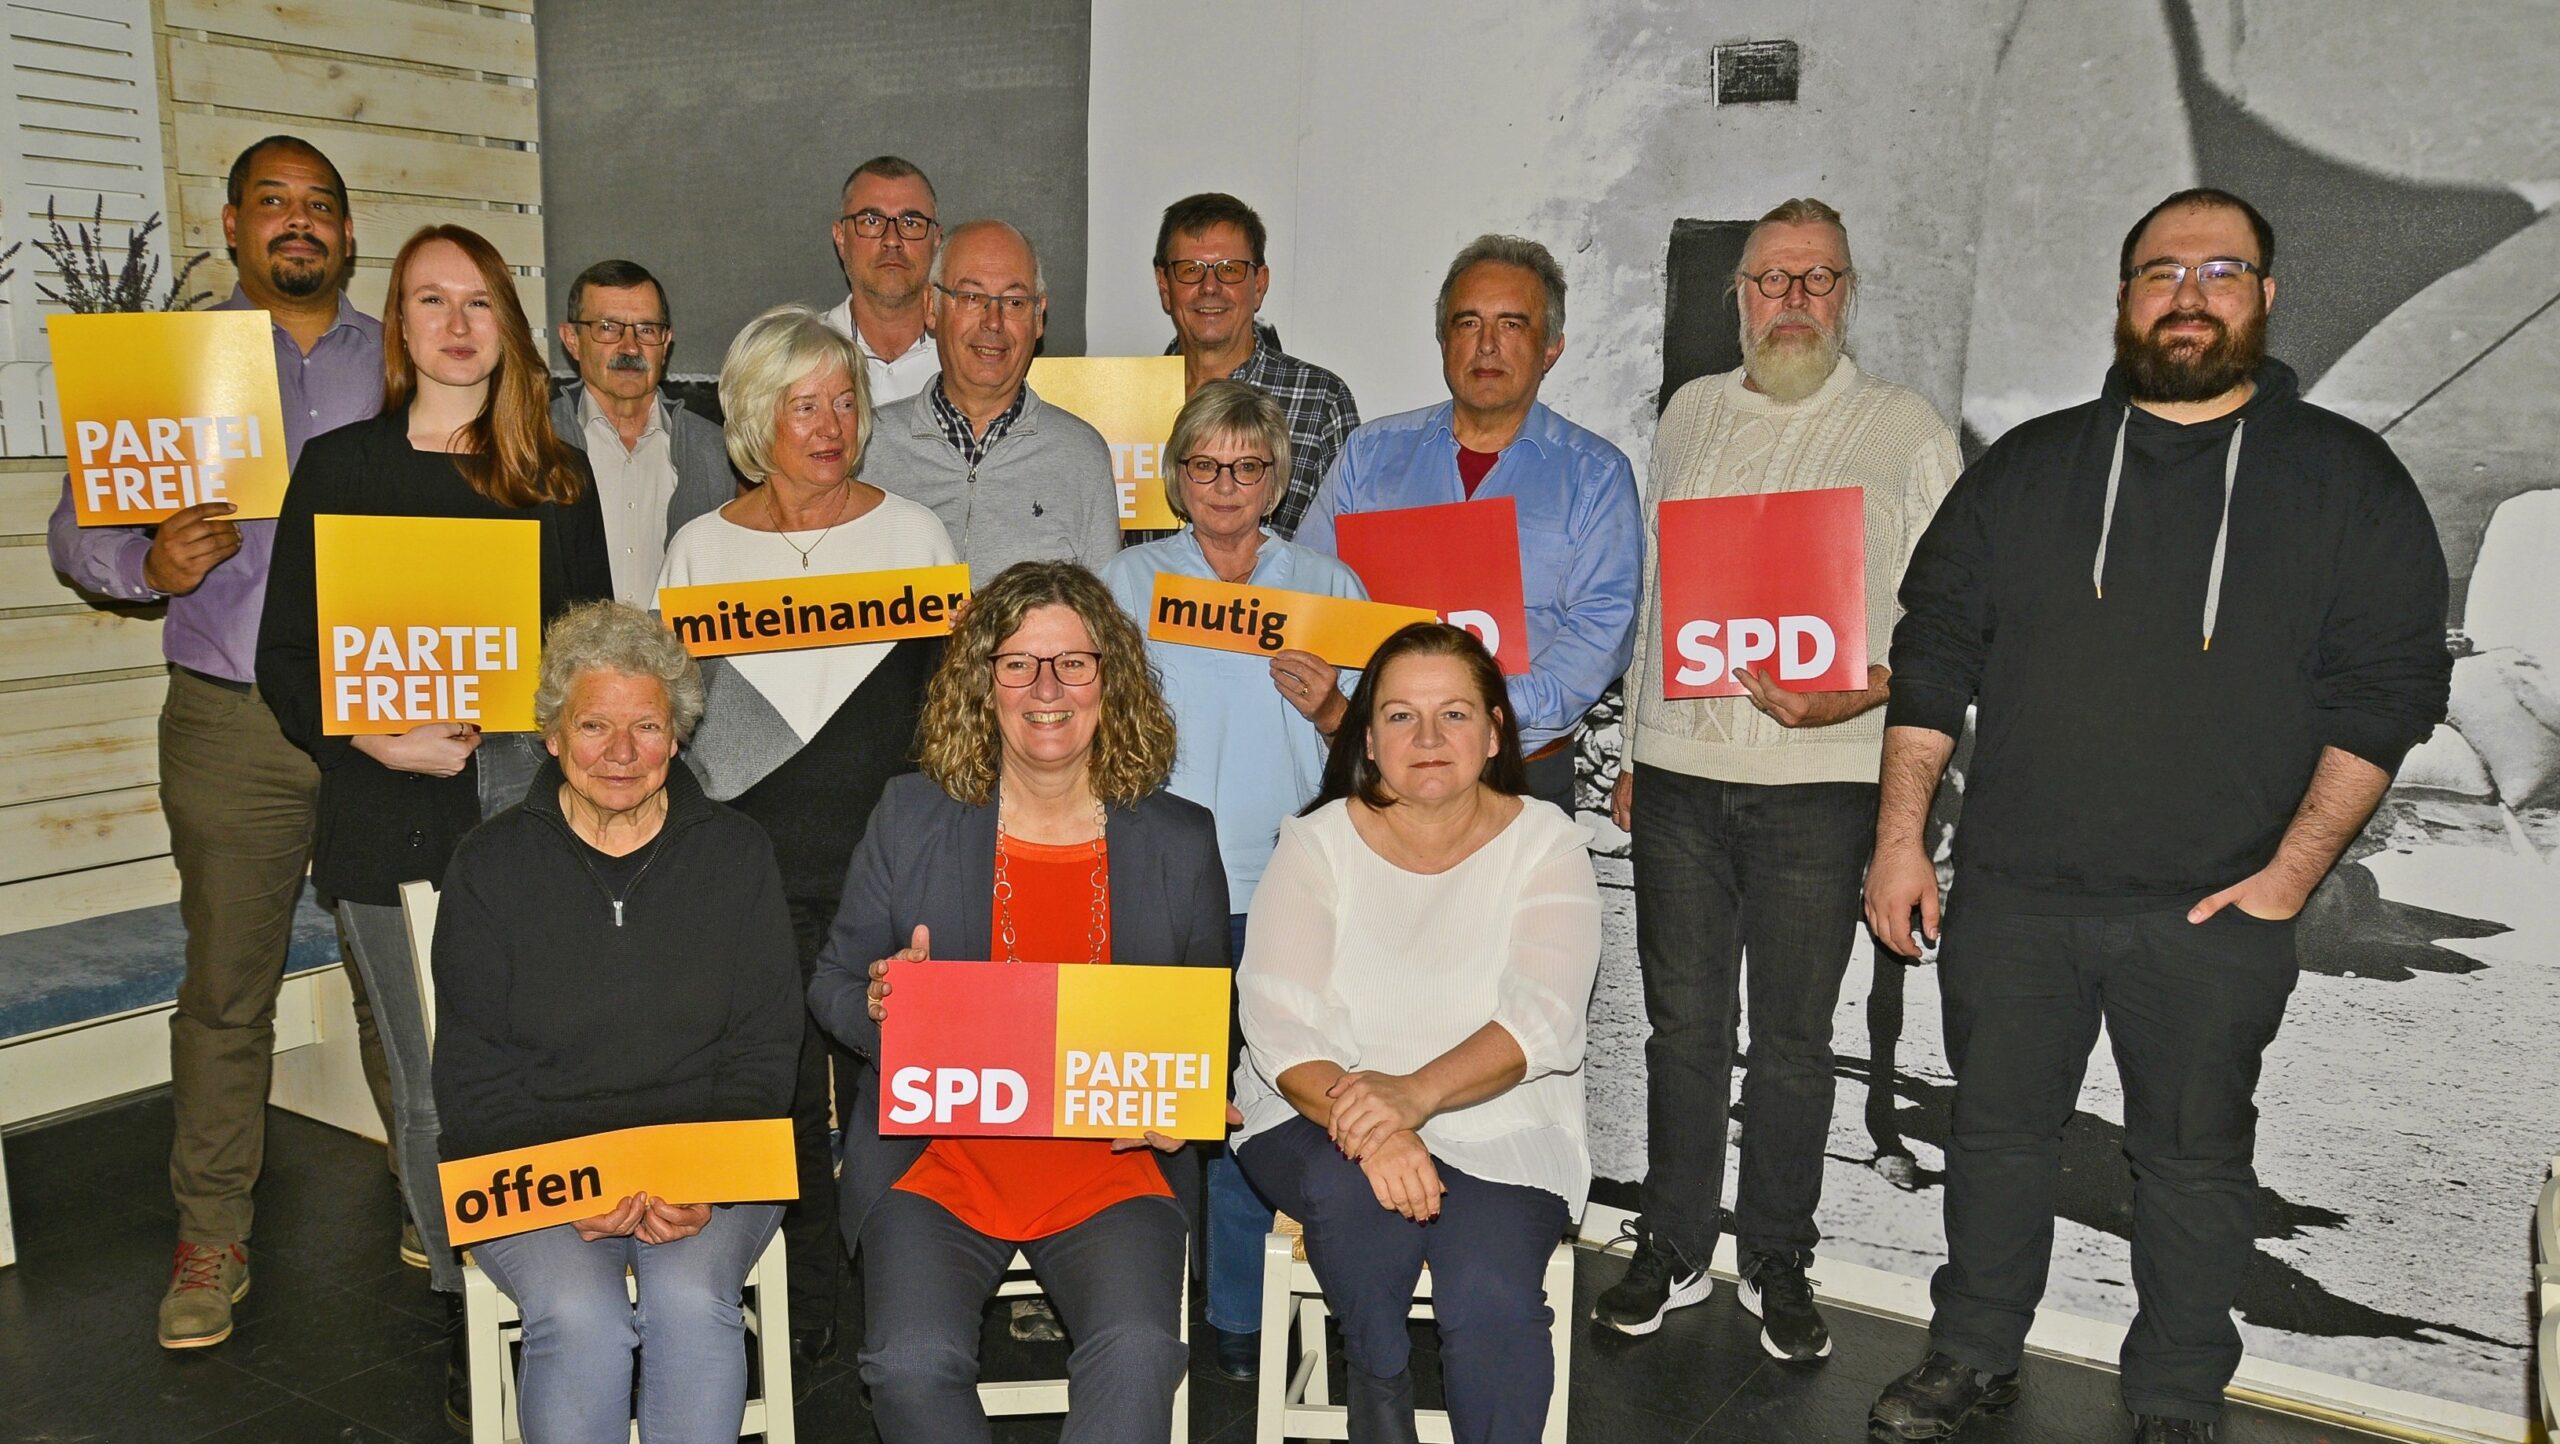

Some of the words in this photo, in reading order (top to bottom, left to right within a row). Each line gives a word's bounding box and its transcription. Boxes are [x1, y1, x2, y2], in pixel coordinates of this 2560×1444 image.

[76, 416, 262, 464] PARTEI
[82, 465, 229, 512] FREIE
[672, 585, 964, 643] miteinander
[1158, 595, 1288, 651] mutig
[332, 626, 518, 671] PARTEI
[1675, 615, 1836, 687] SPD
[335, 675, 481, 722] FREIE
[1066, 1050, 1210, 1089] PARTEI
[888, 1066, 1029, 1125] SPD
[1064, 1089, 1177, 1128] FREIE
[455, 1164, 602, 1224] offen
